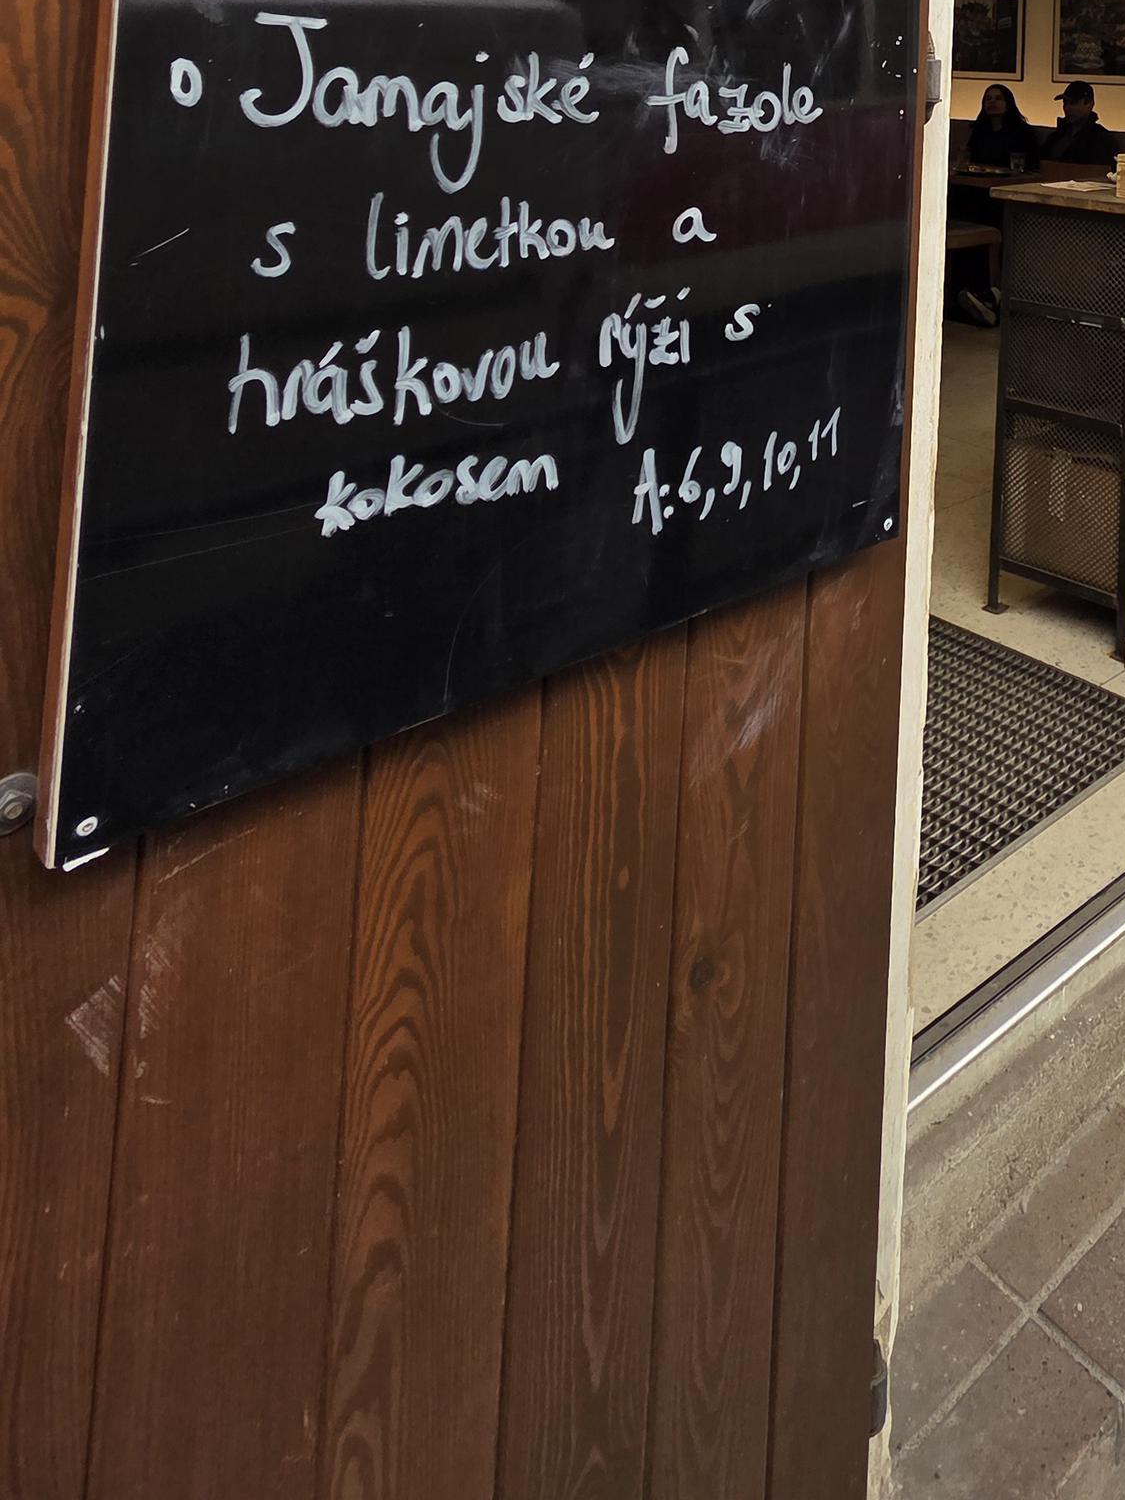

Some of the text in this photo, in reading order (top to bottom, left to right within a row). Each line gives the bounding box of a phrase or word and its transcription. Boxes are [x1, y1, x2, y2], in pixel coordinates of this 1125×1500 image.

[240, 12, 824, 194] Jamajské fazole
[366, 191, 615, 280] limetkou
[672, 206, 718, 244] a
[229, 325, 560, 435] hráškovou
[598, 286, 691, 445] rýží
[315, 454, 560, 538] kokosem
